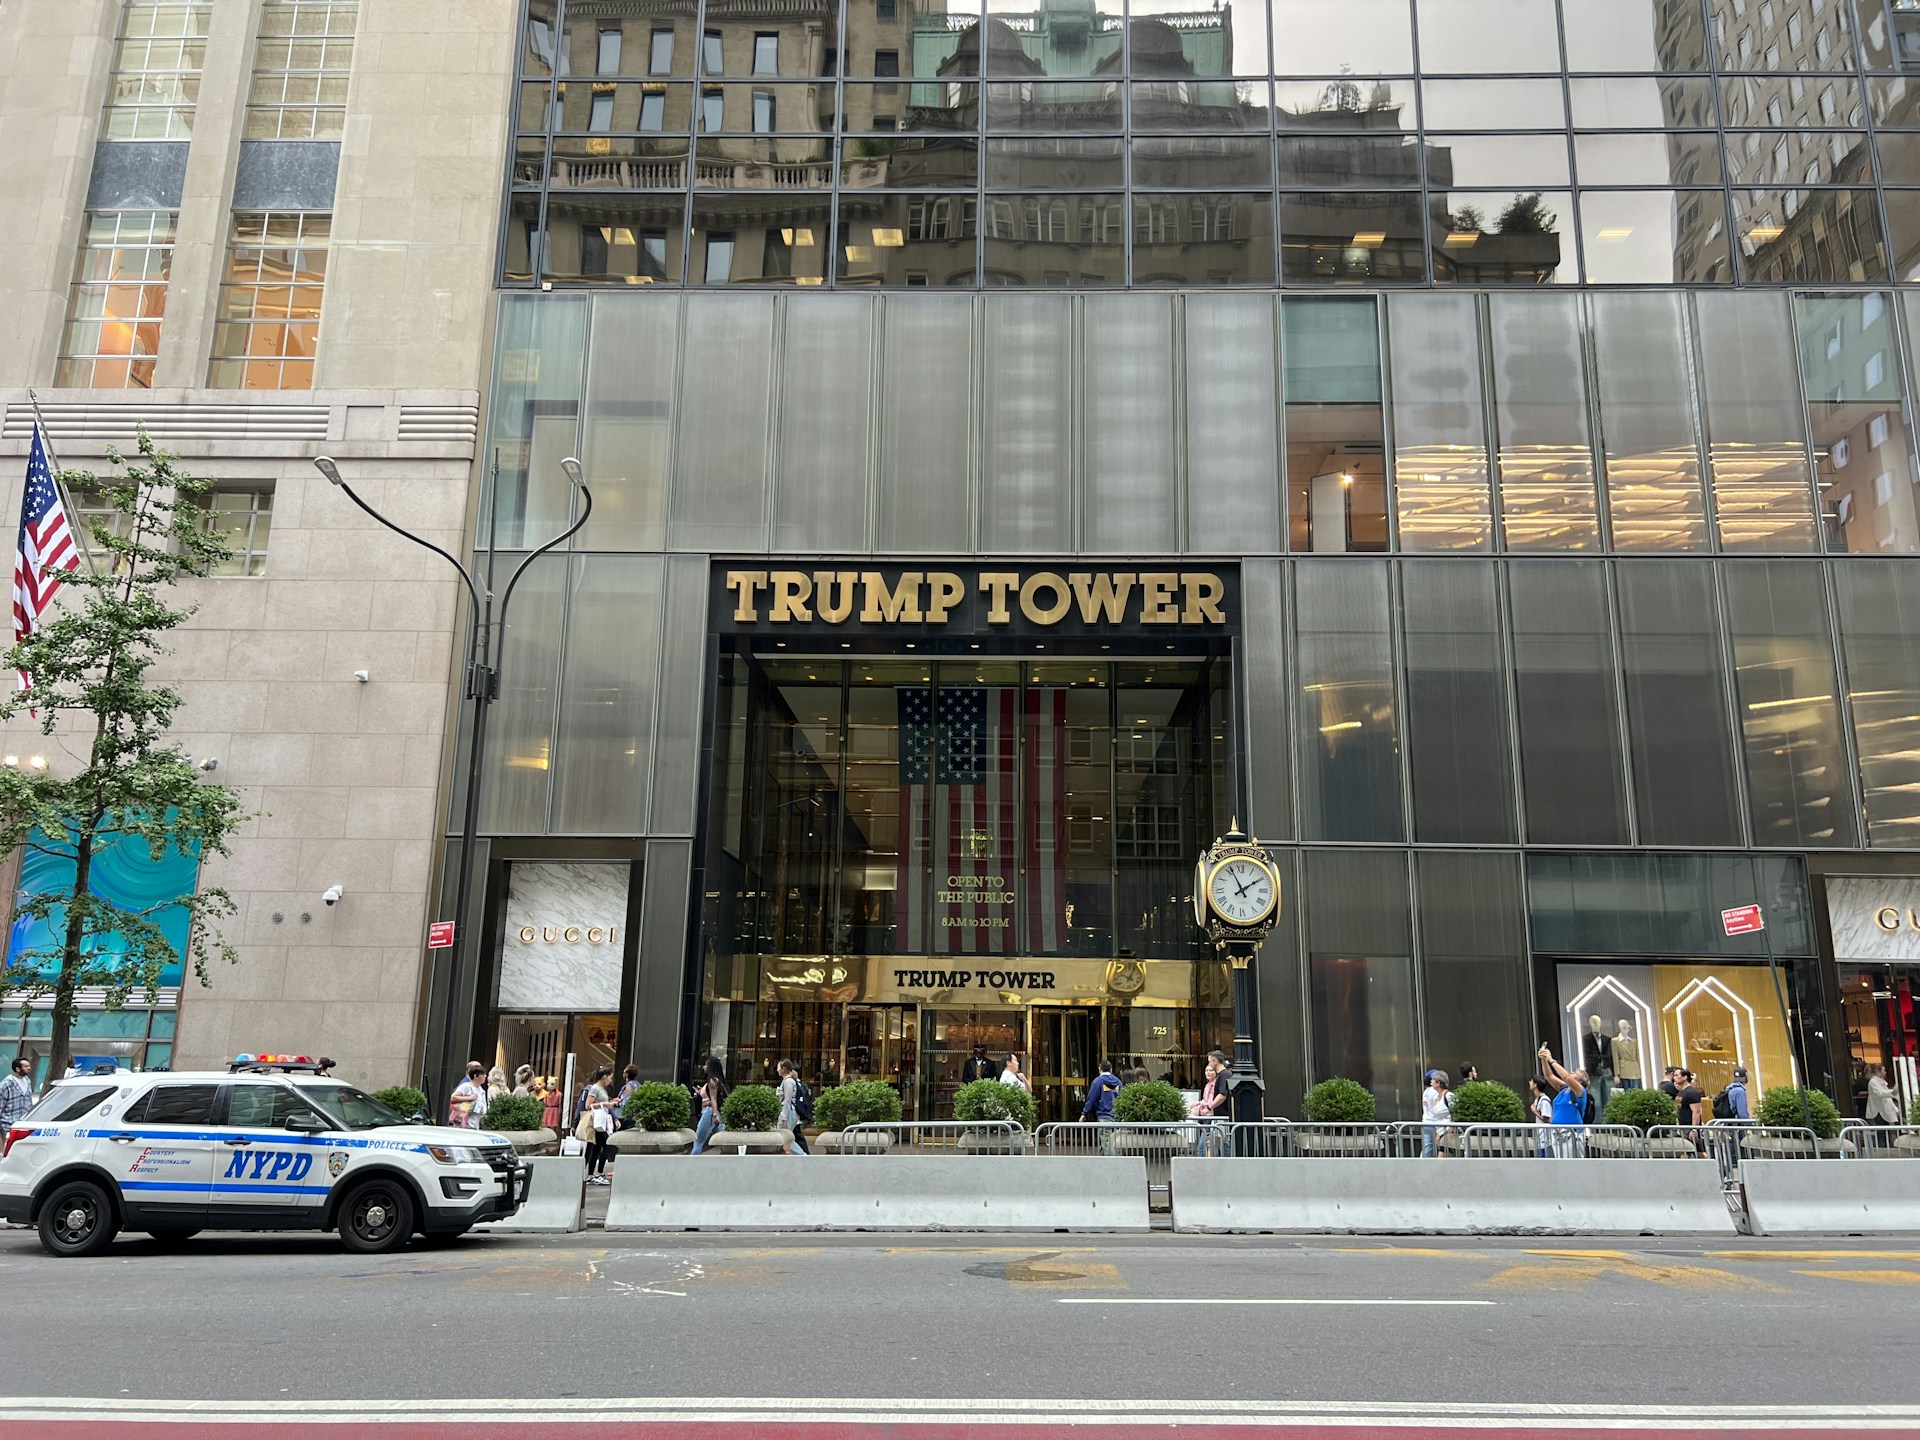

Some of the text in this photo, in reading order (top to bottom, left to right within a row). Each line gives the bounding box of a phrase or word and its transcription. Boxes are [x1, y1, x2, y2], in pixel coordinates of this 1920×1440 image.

[726, 570, 1226, 626] TRUMP TOWER
[1217, 847, 1239, 858] TRUMP
[947, 875, 1005, 888] OPEN TO
[937, 891, 1015, 905] THE PUBLIC
[941, 917, 947, 927] 8
[948, 917, 967, 927] AM
[968, 918, 979, 928] to
[992, 917, 1010, 928] PM
[519, 926, 616, 943] GUCCI
[894, 969, 1055, 989] TRUMP TOWER
[1152, 1026, 1167, 1035] 725
[367, 1140, 401, 1150] POLICE
[223, 1149, 313, 1181] NYPD
